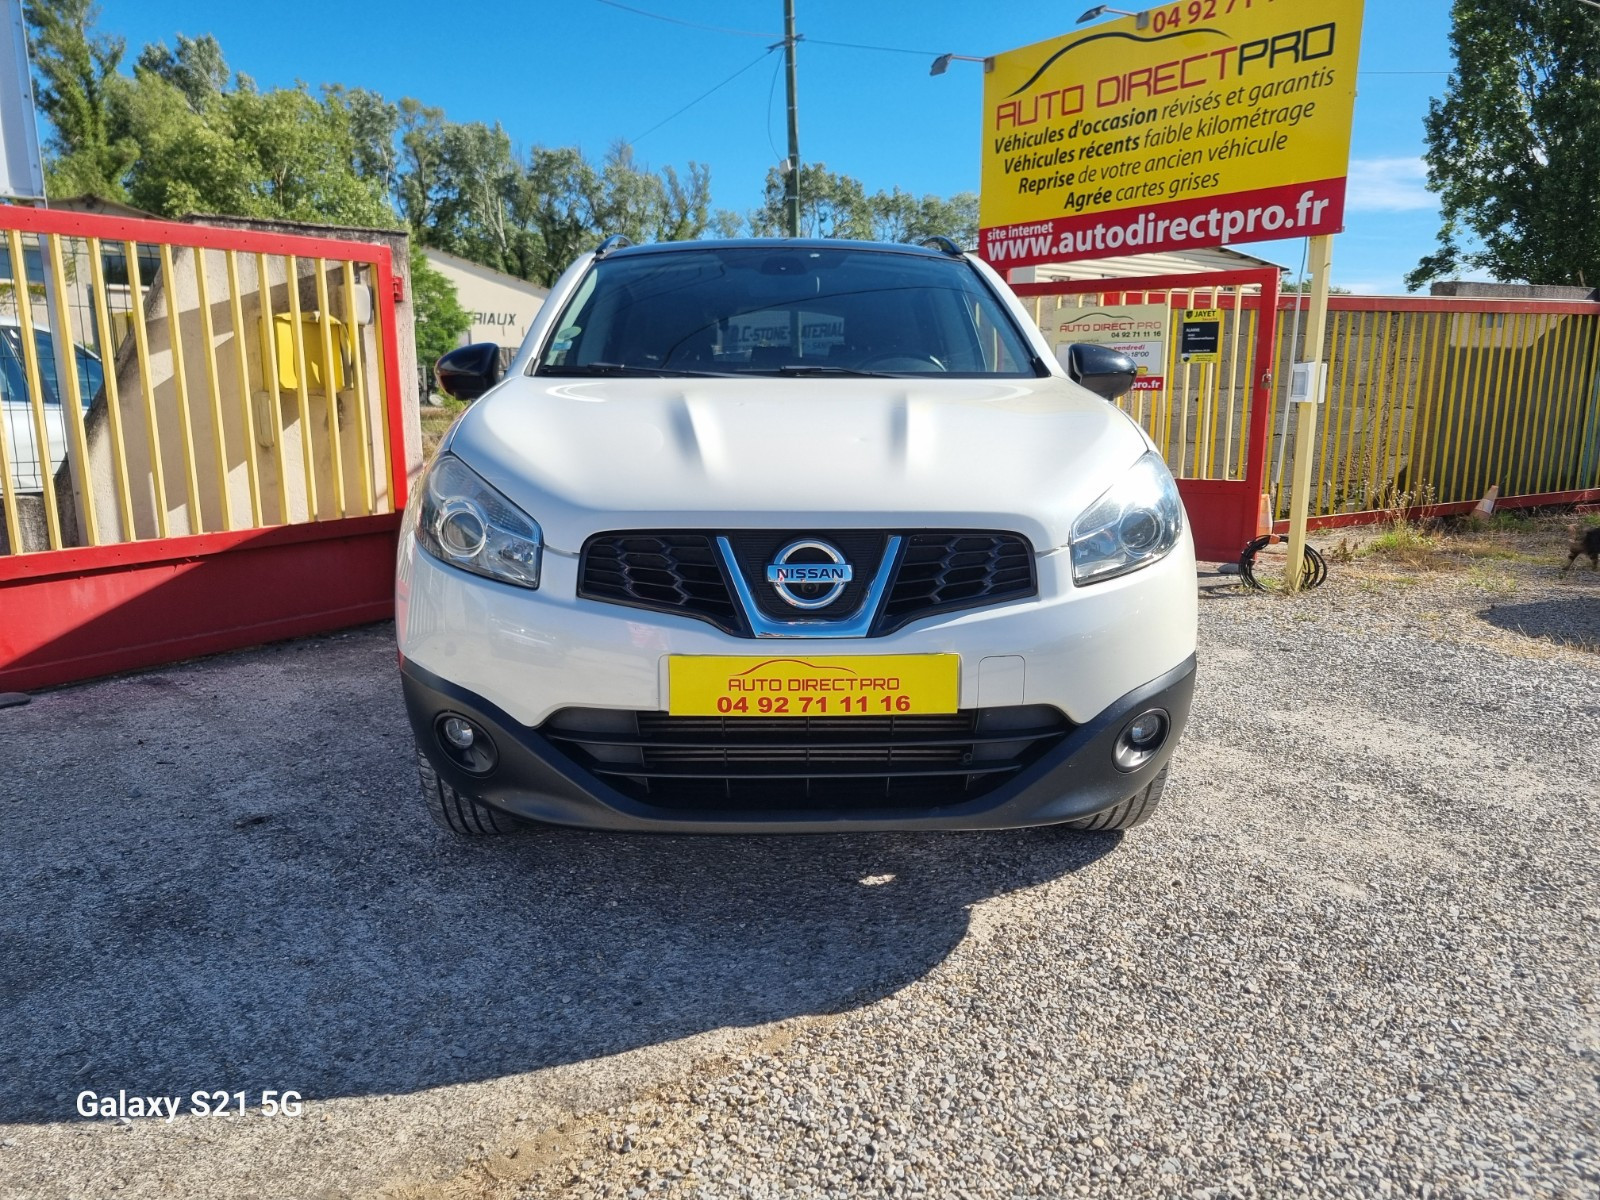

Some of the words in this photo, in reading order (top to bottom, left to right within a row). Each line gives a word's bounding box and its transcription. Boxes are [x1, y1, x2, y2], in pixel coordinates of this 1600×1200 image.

[1153, 6, 1181, 33] 04
[1188, 0, 1216, 24] 92
[995, 127, 1064, 154] Véhicules
[1068, 107, 1157, 139] d'occasion
[1161, 91, 1221, 120] révisés
[1226, 87, 1246, 106] et
[1248, 66, 1336, 108] garantis
[996, 84, 1084, 131] AUTO
[1004, 148, 1075, 174] Véhicules
[1078, 134, 1140, 161] récents
[1144, 120, 1193, 148] faible
[1196, 102, 1316, 139] kilométrage
[1018, 171, 1075, 196] Reprise
[1078, 165, 1097, 184] de
[1101, 160, 1141, 180] votre
[1144, 149, 1203, 173] ancien
[1208, 130, 1288, 162] véhicule
[1064, 187, 1112, 212] Agrée
[1116, 181, 1165, 201] cartes
[1168, 172, 1220, 199] grises
[987, 190, 1329, 262] www.autodirectpro.fr
[987, 228, 1006, 241] site
[1008, 222, 1054, 239] internet
[465, 312, 517, 327] RIAUX
[1060, 323, 1090, 333] AUTO
[1093, 322, 1134, 332] DIRECT
[1137, 321, 1161, 330] PRO
[1194, 310, 1216, 318] JAYET
[777, 568, 844, 580] NISSAN
[728, 678, 781, 691] AUTO
[717, 697, 749, 713] 04
[757, 697, 789, 713] 92
[798, 697, 828, 713] 71
[840, 696, 868, 712] 11
[880, 695, 910, 712] 16
